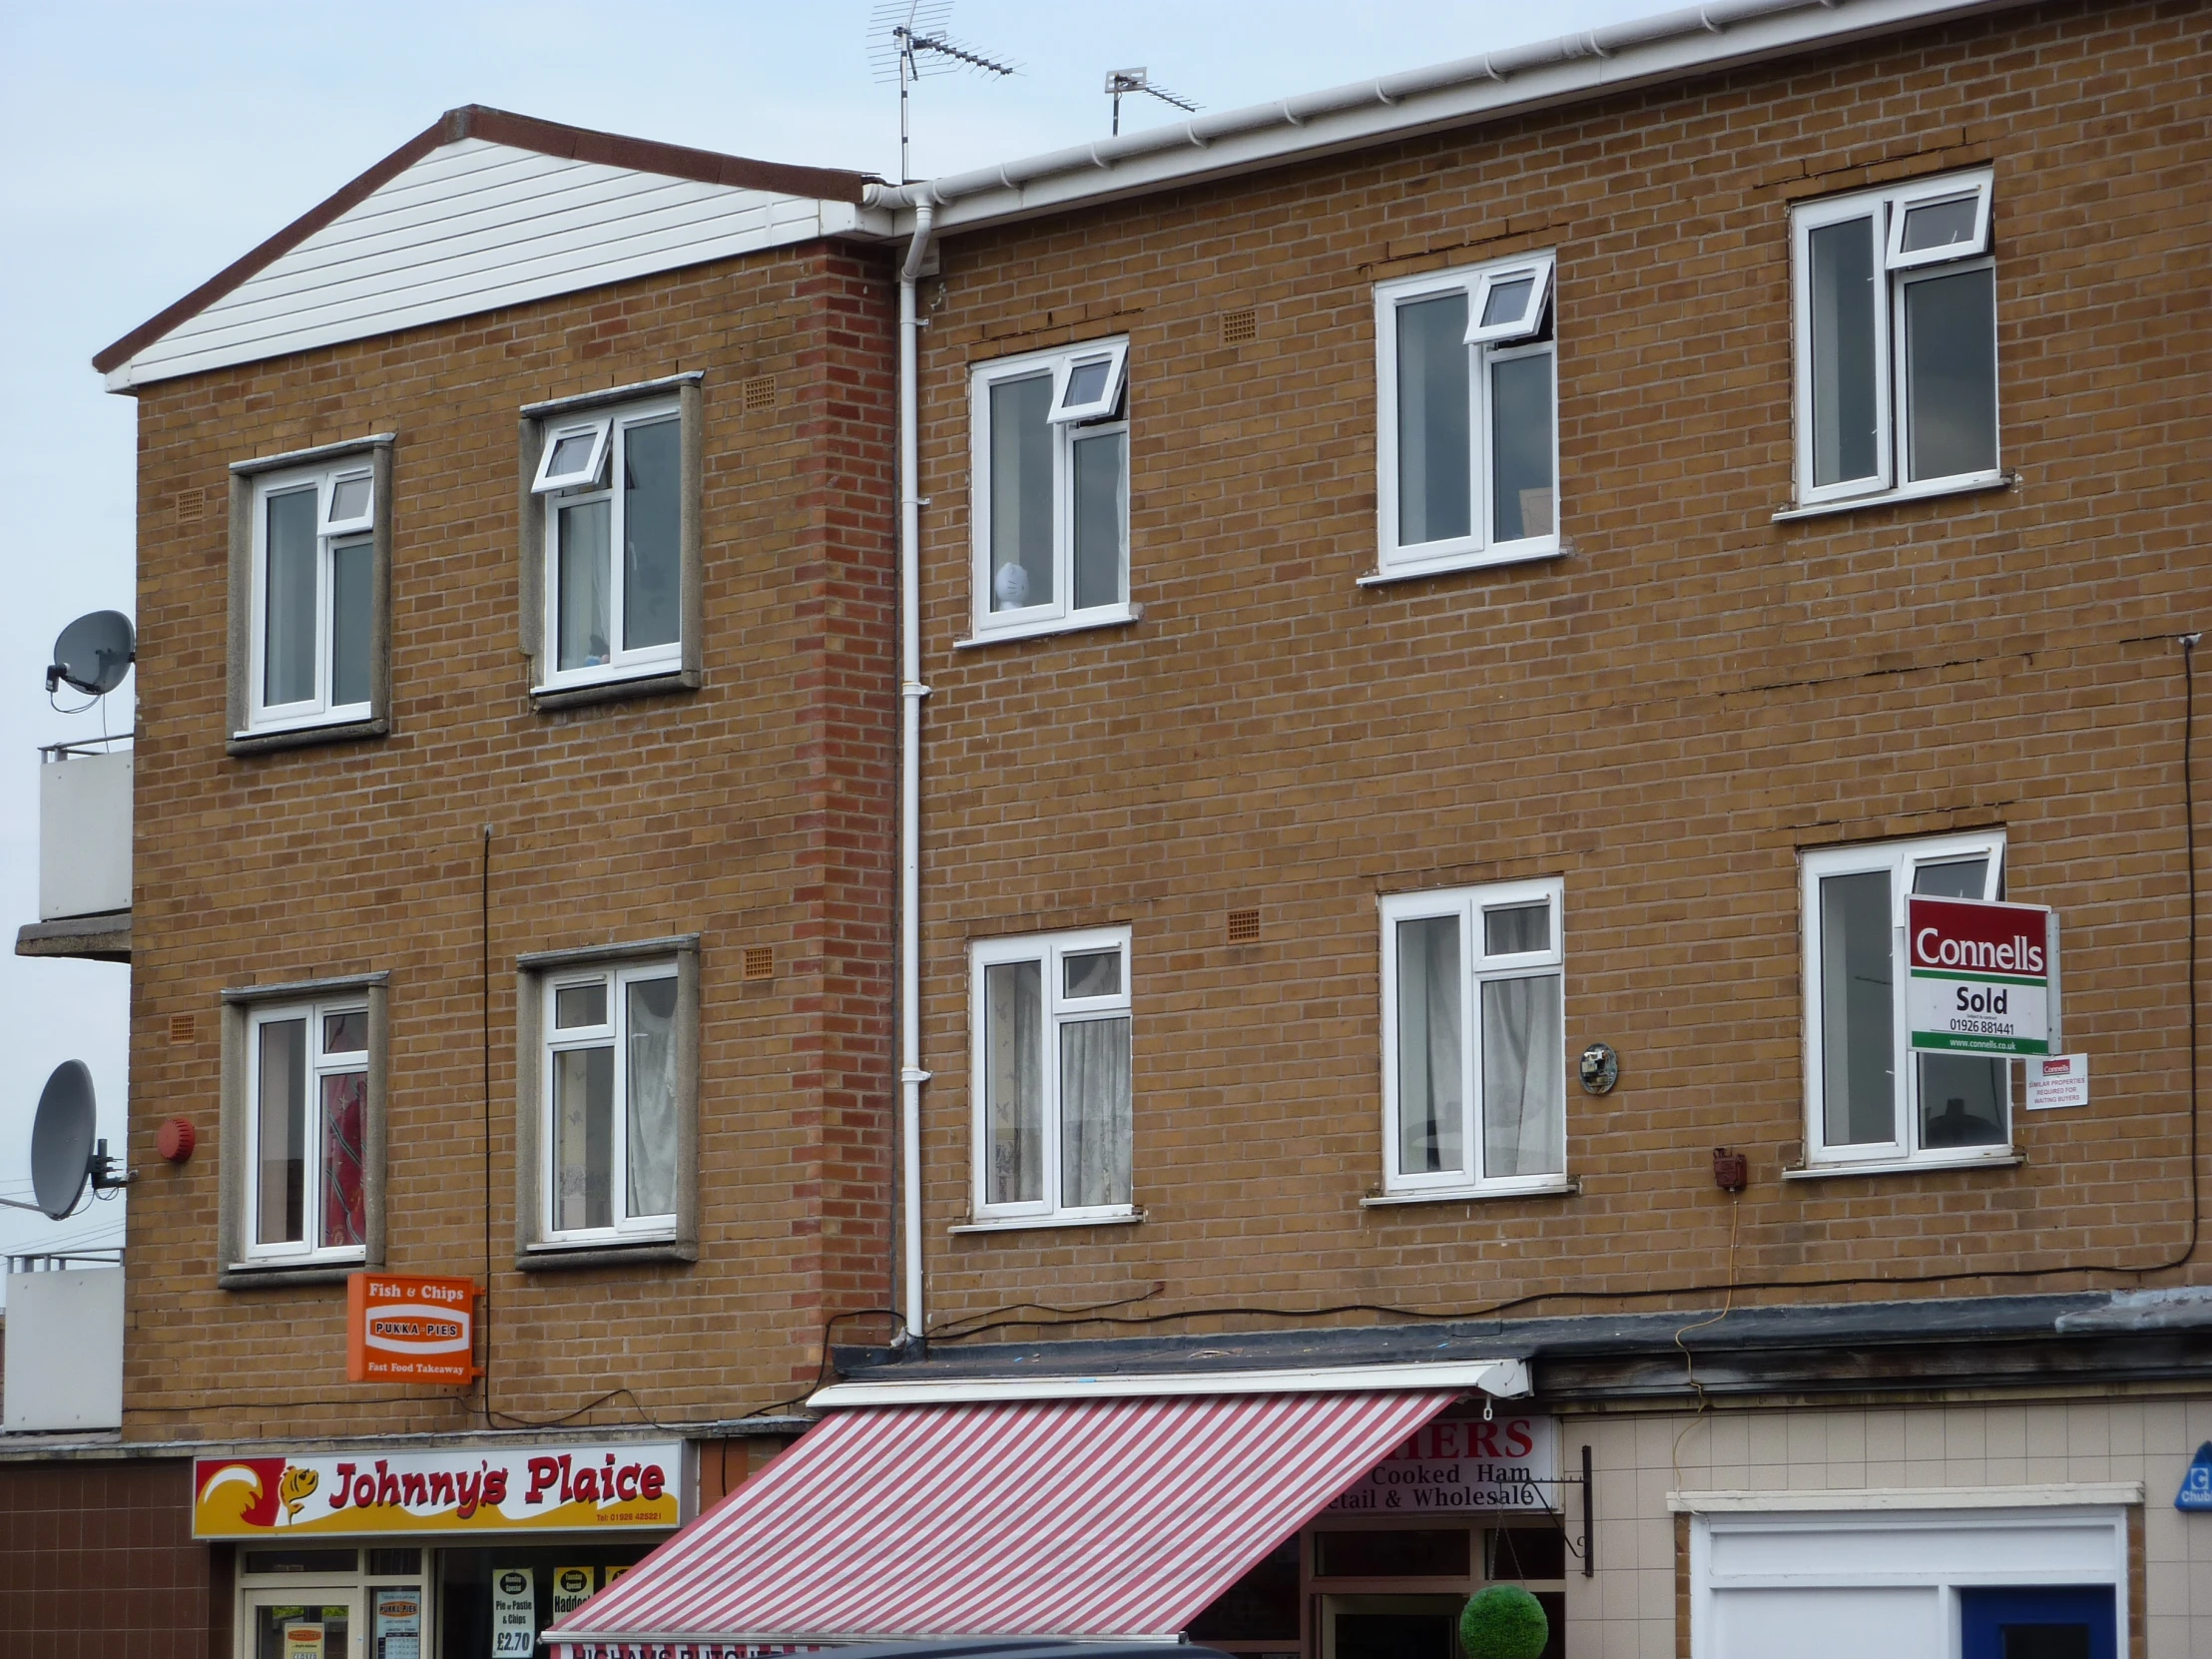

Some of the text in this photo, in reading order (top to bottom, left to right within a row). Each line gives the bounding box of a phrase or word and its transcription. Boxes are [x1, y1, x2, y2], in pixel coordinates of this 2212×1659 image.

[1917, 927, 2044, 972] Connells
[1956, 986, 2007, 1015] Sold
[1950, 1018, 2014, 1035] 01926 881441
[1949, 1038, 2016, 1050] www.connells.co.uk
[2044, 1064, 2069, 1073] Connells
[369, 1283, 464, 1302] Fish & Chips
[368, 1363, 464, 1376] Fast Food Takeaway
[1372, 1463, 1530, 1485] Cooked Ham
[329, 1453, 666, 1519] Johnny's Plaice
[1385, 1490, 1400, 1508] &
[1413, 1484, 1534, 1506] Wholesale
[496, 1600, 506, 1610] Pie
[512, 1600, 532, 1610] Pastie
[508, 1614, 526, 1625] Chips
[497, 1632, 530, 1651] £2.70
